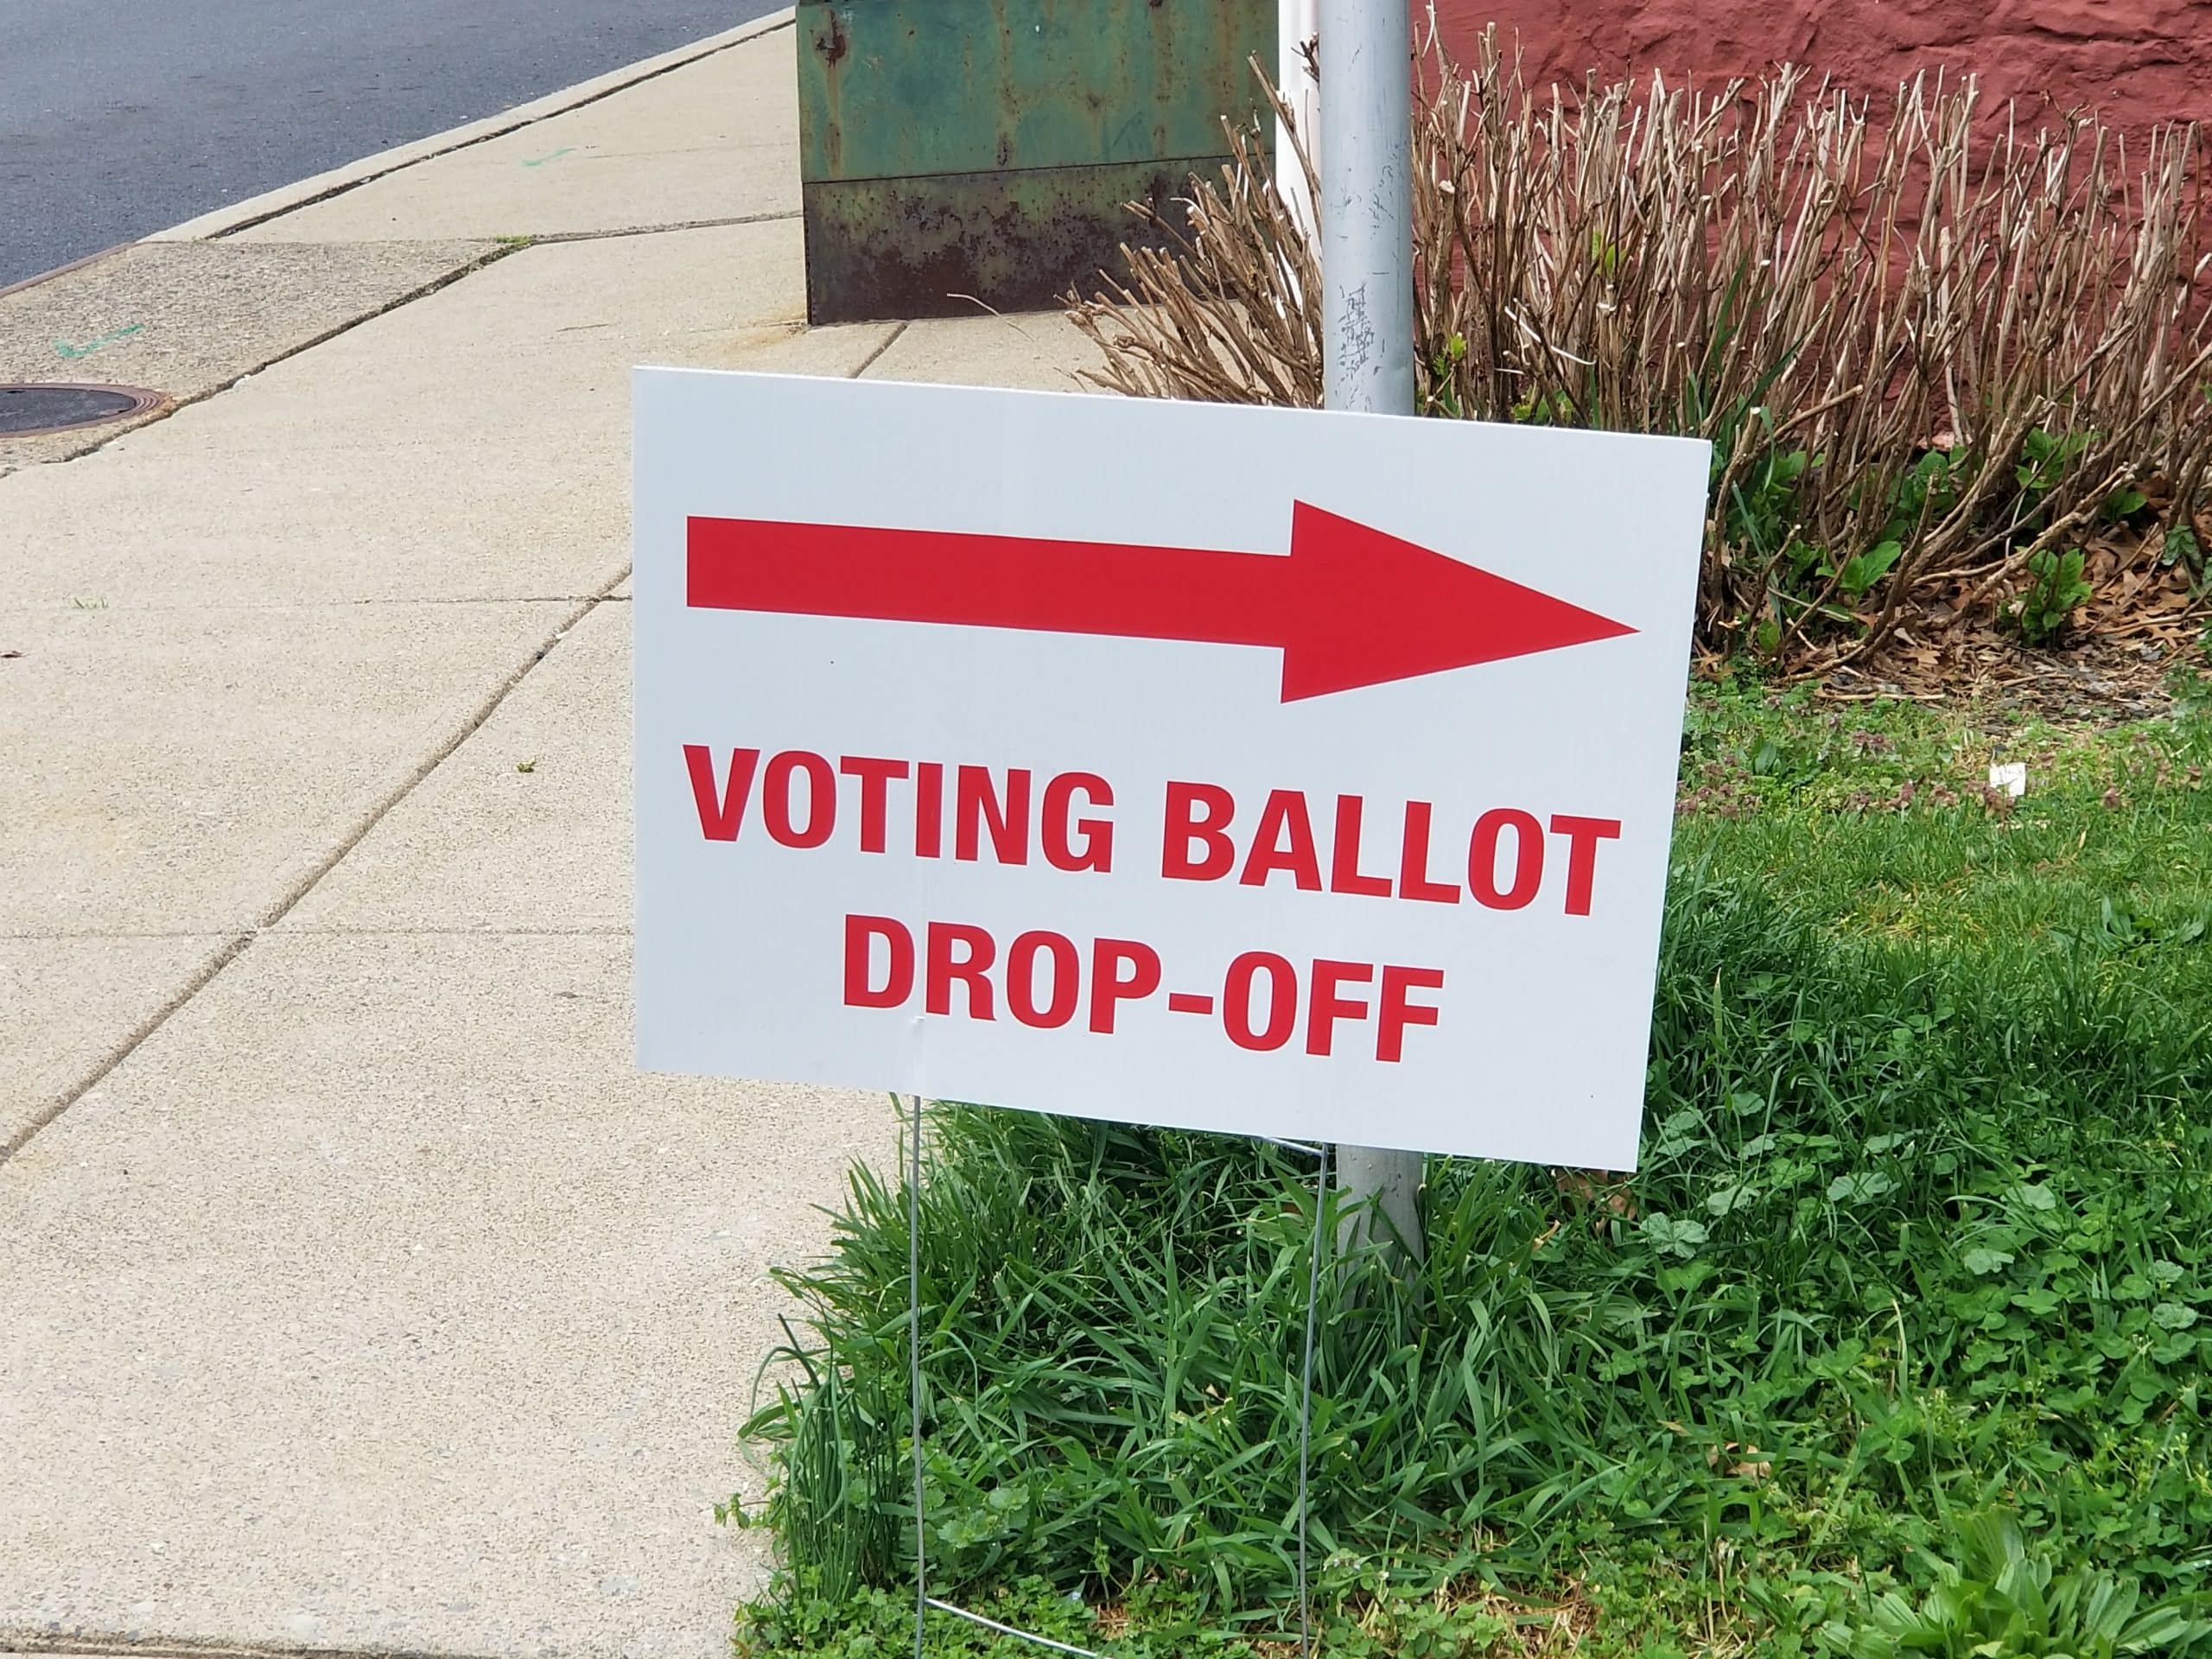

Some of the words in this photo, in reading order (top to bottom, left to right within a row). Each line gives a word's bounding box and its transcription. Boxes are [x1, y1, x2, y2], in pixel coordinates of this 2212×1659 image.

[683, 745, 1114, 873] VOTING
[1162, 780, 1622, 917] BALLOT
[844, 915, 1445, 1063] DROP-OFF
